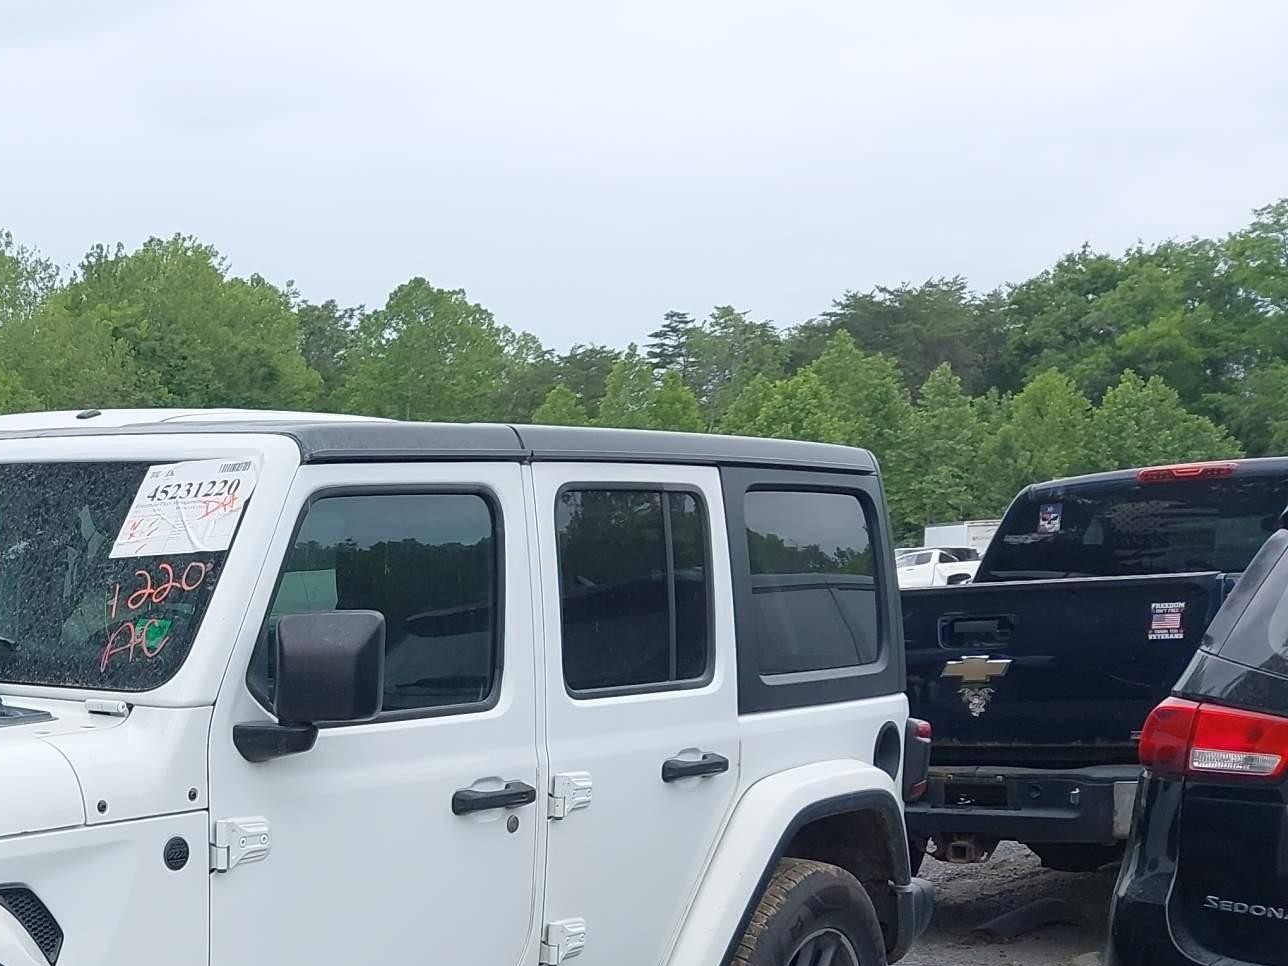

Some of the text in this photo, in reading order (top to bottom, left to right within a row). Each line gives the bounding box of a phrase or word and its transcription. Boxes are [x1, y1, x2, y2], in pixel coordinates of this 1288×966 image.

[146, 478, 241, 502] 45231220
[111, 561, 206, 619] 1220
[1203, 895, 1288, 920] SEDON
